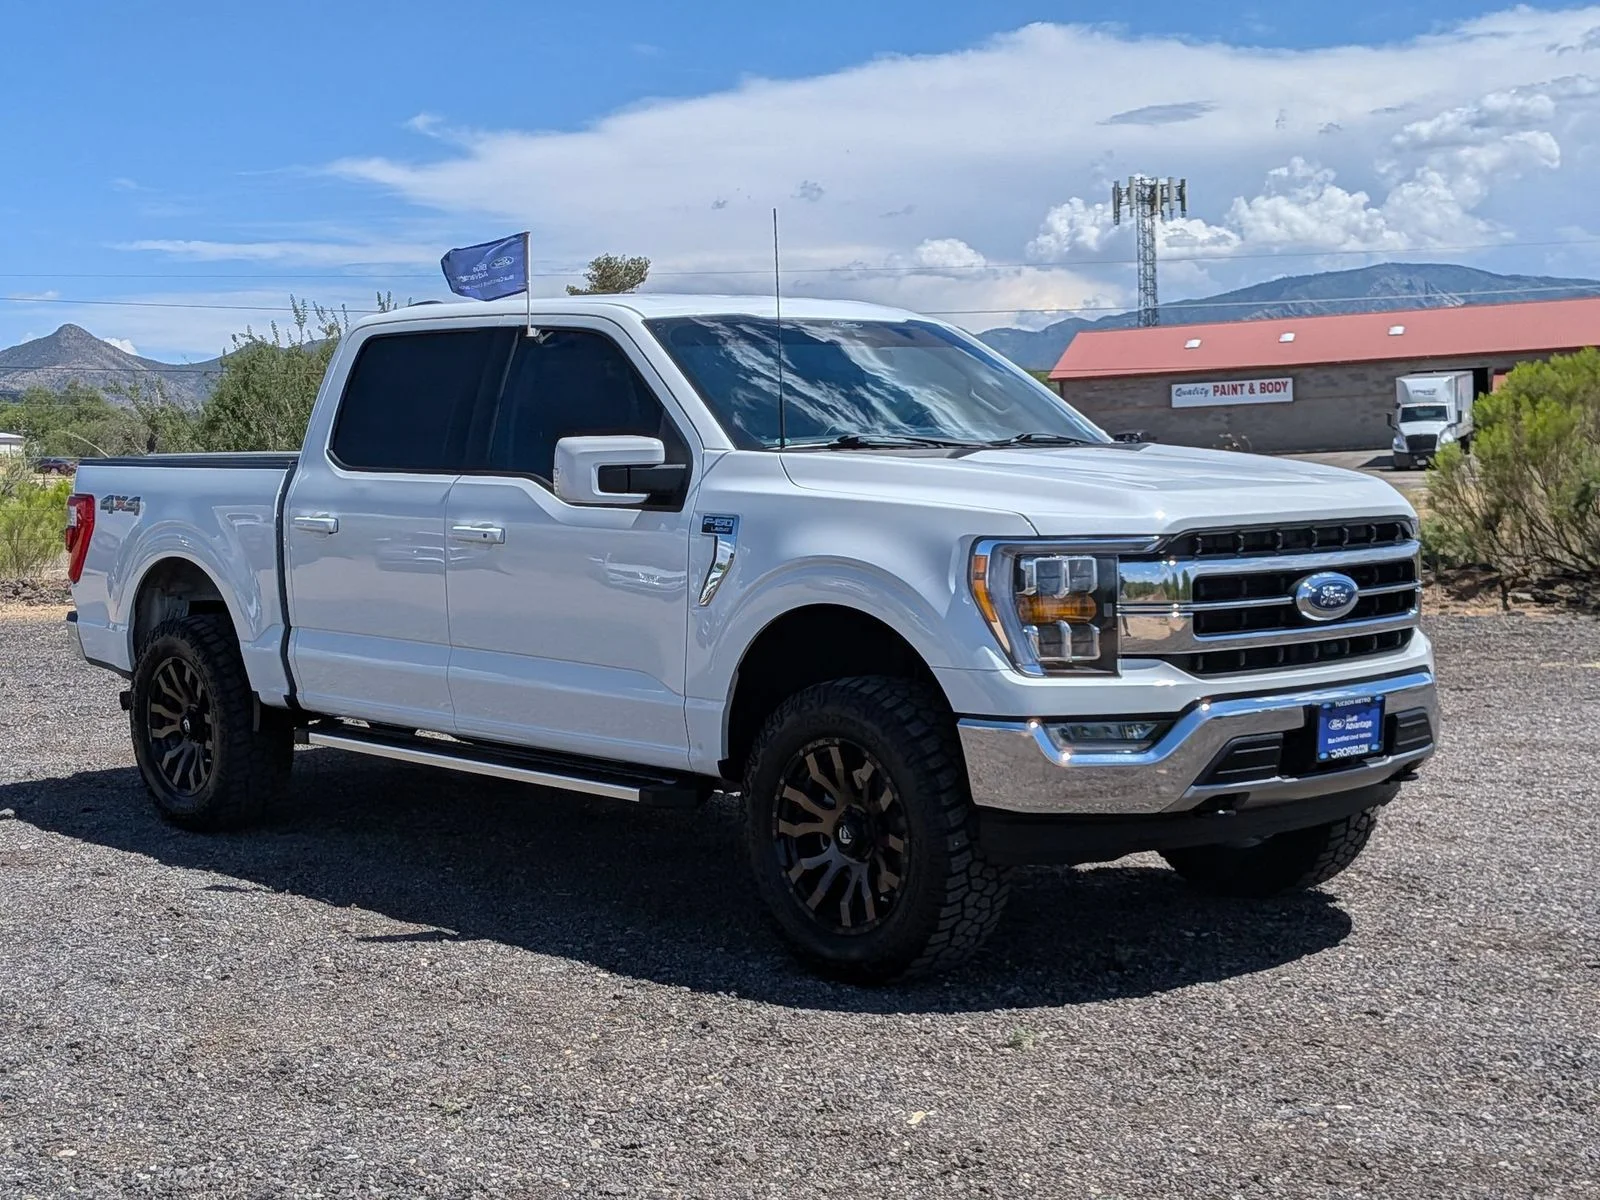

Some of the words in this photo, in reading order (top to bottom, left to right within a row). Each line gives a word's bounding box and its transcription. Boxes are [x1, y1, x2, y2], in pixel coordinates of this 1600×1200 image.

[1175, 387, 1211, 398] Quality
[1213, 383, 1246, 397] PAINT
[1248, 382, 1256, 395] &
[1259, 381, 1289, 394] BODY
[1319, 584, 1349, 607] Ford
[1335, 700, 1354, 708] TUCSON
[1355, 696, 1371, 704] METRO
[1345, 720, 1372, 730] Advantage
